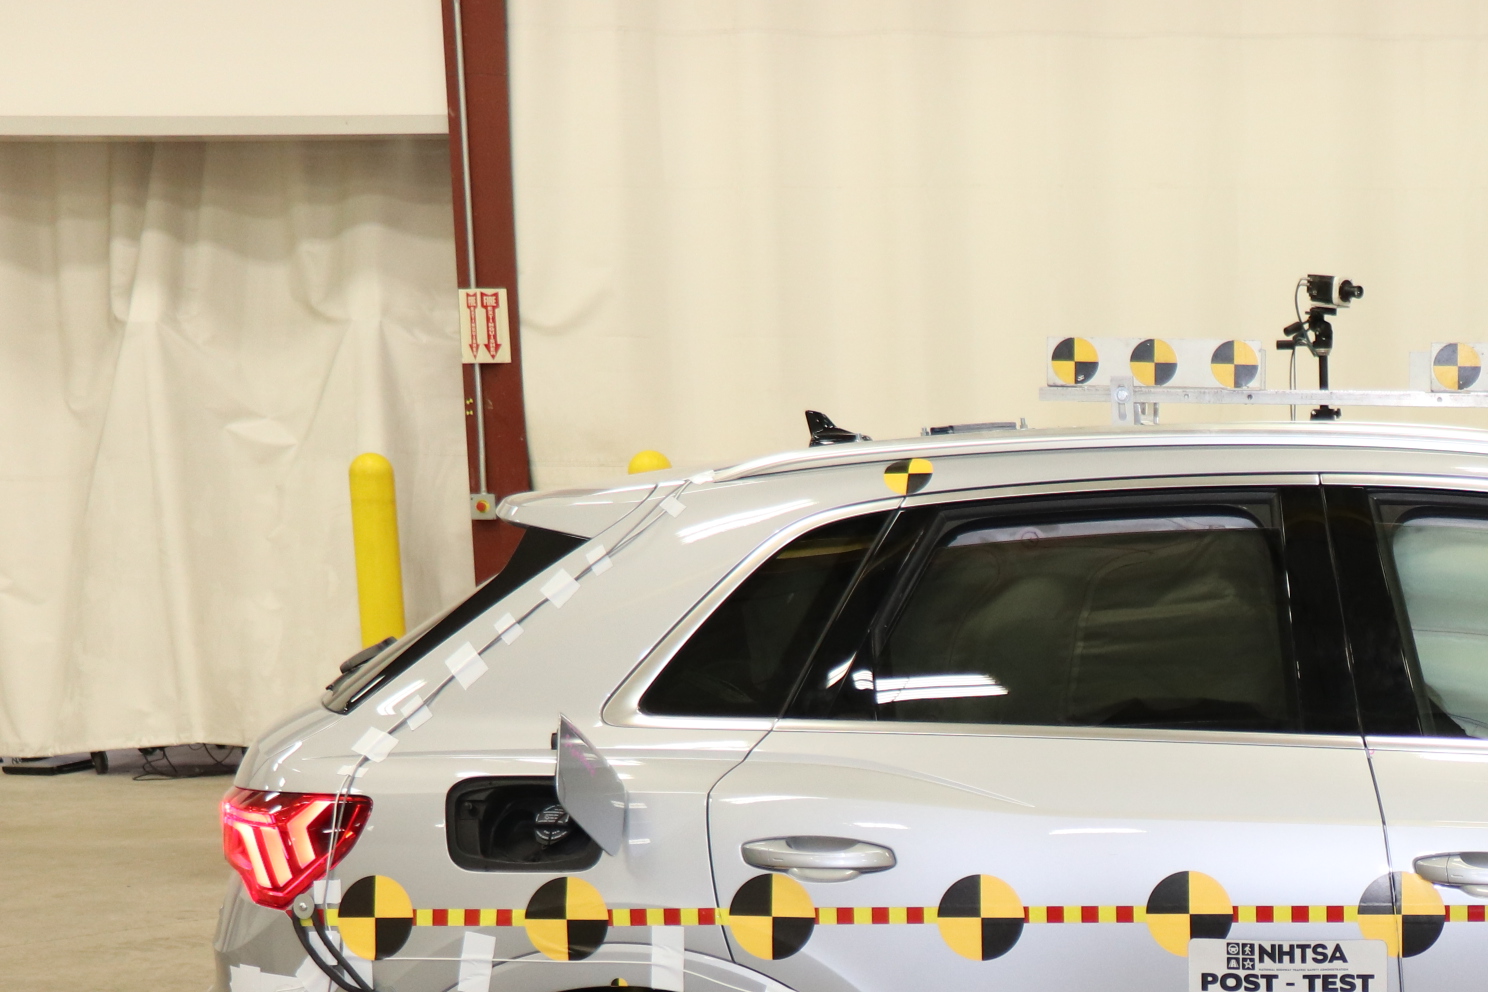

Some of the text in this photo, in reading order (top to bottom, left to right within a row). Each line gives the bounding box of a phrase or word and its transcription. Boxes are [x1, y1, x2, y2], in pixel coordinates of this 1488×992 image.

[483, 296, 497, 306] FIRE
[487, 307, 496, 355] EXTINGUISHER
[1258, 943, 1348, 964] NHTSA
[1201, 973, 1278, 992] POST
[1302, 974, 1374, 992] TEST
